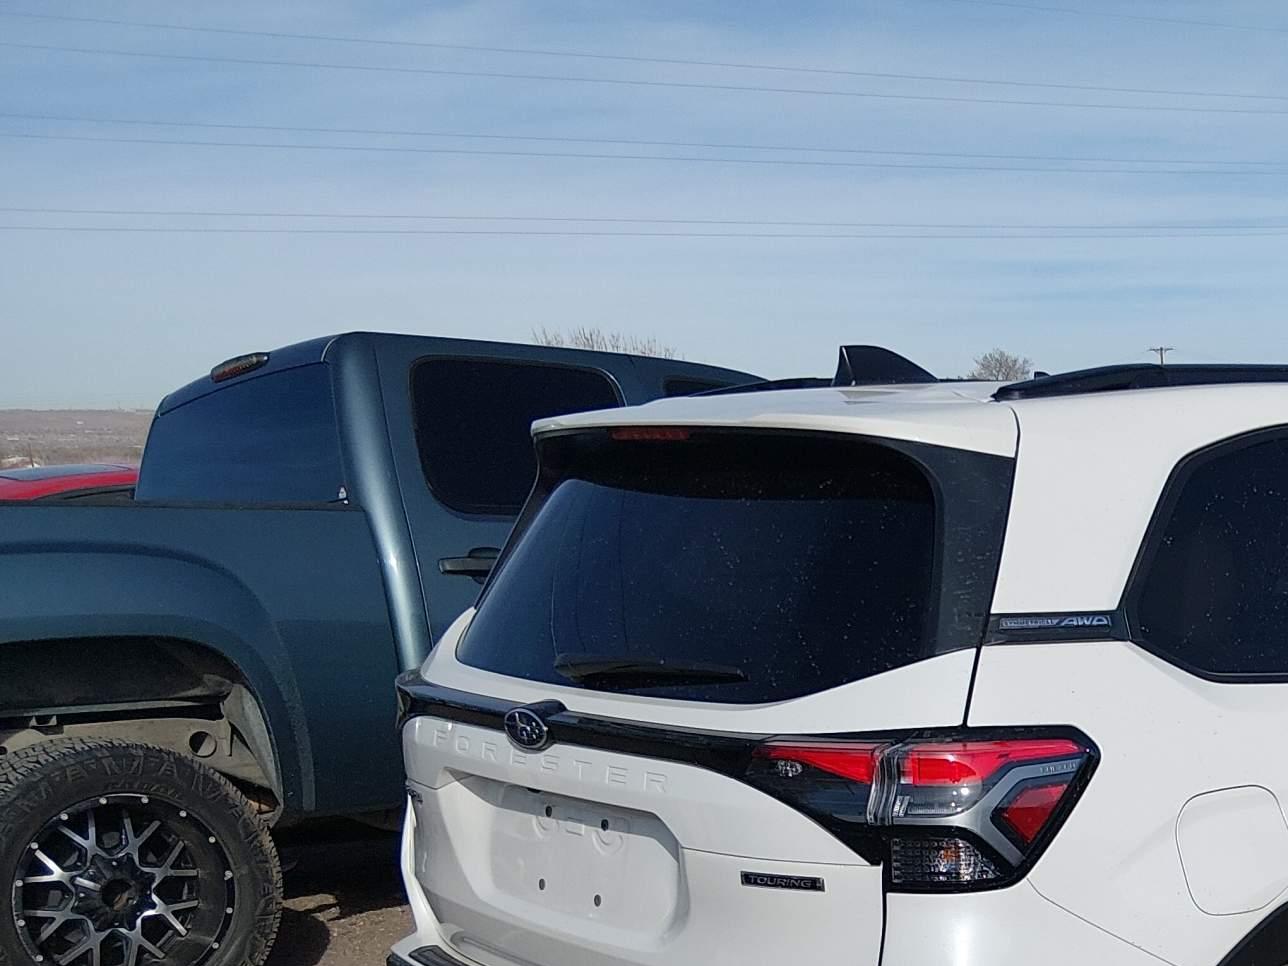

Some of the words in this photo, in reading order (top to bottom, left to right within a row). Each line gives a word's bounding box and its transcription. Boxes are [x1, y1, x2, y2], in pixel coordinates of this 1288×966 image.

[1061, 615, 1109, 627] AWD
[431, 728, 668, 793] FORESTER
[748, 875, 812, 888] TOURING
